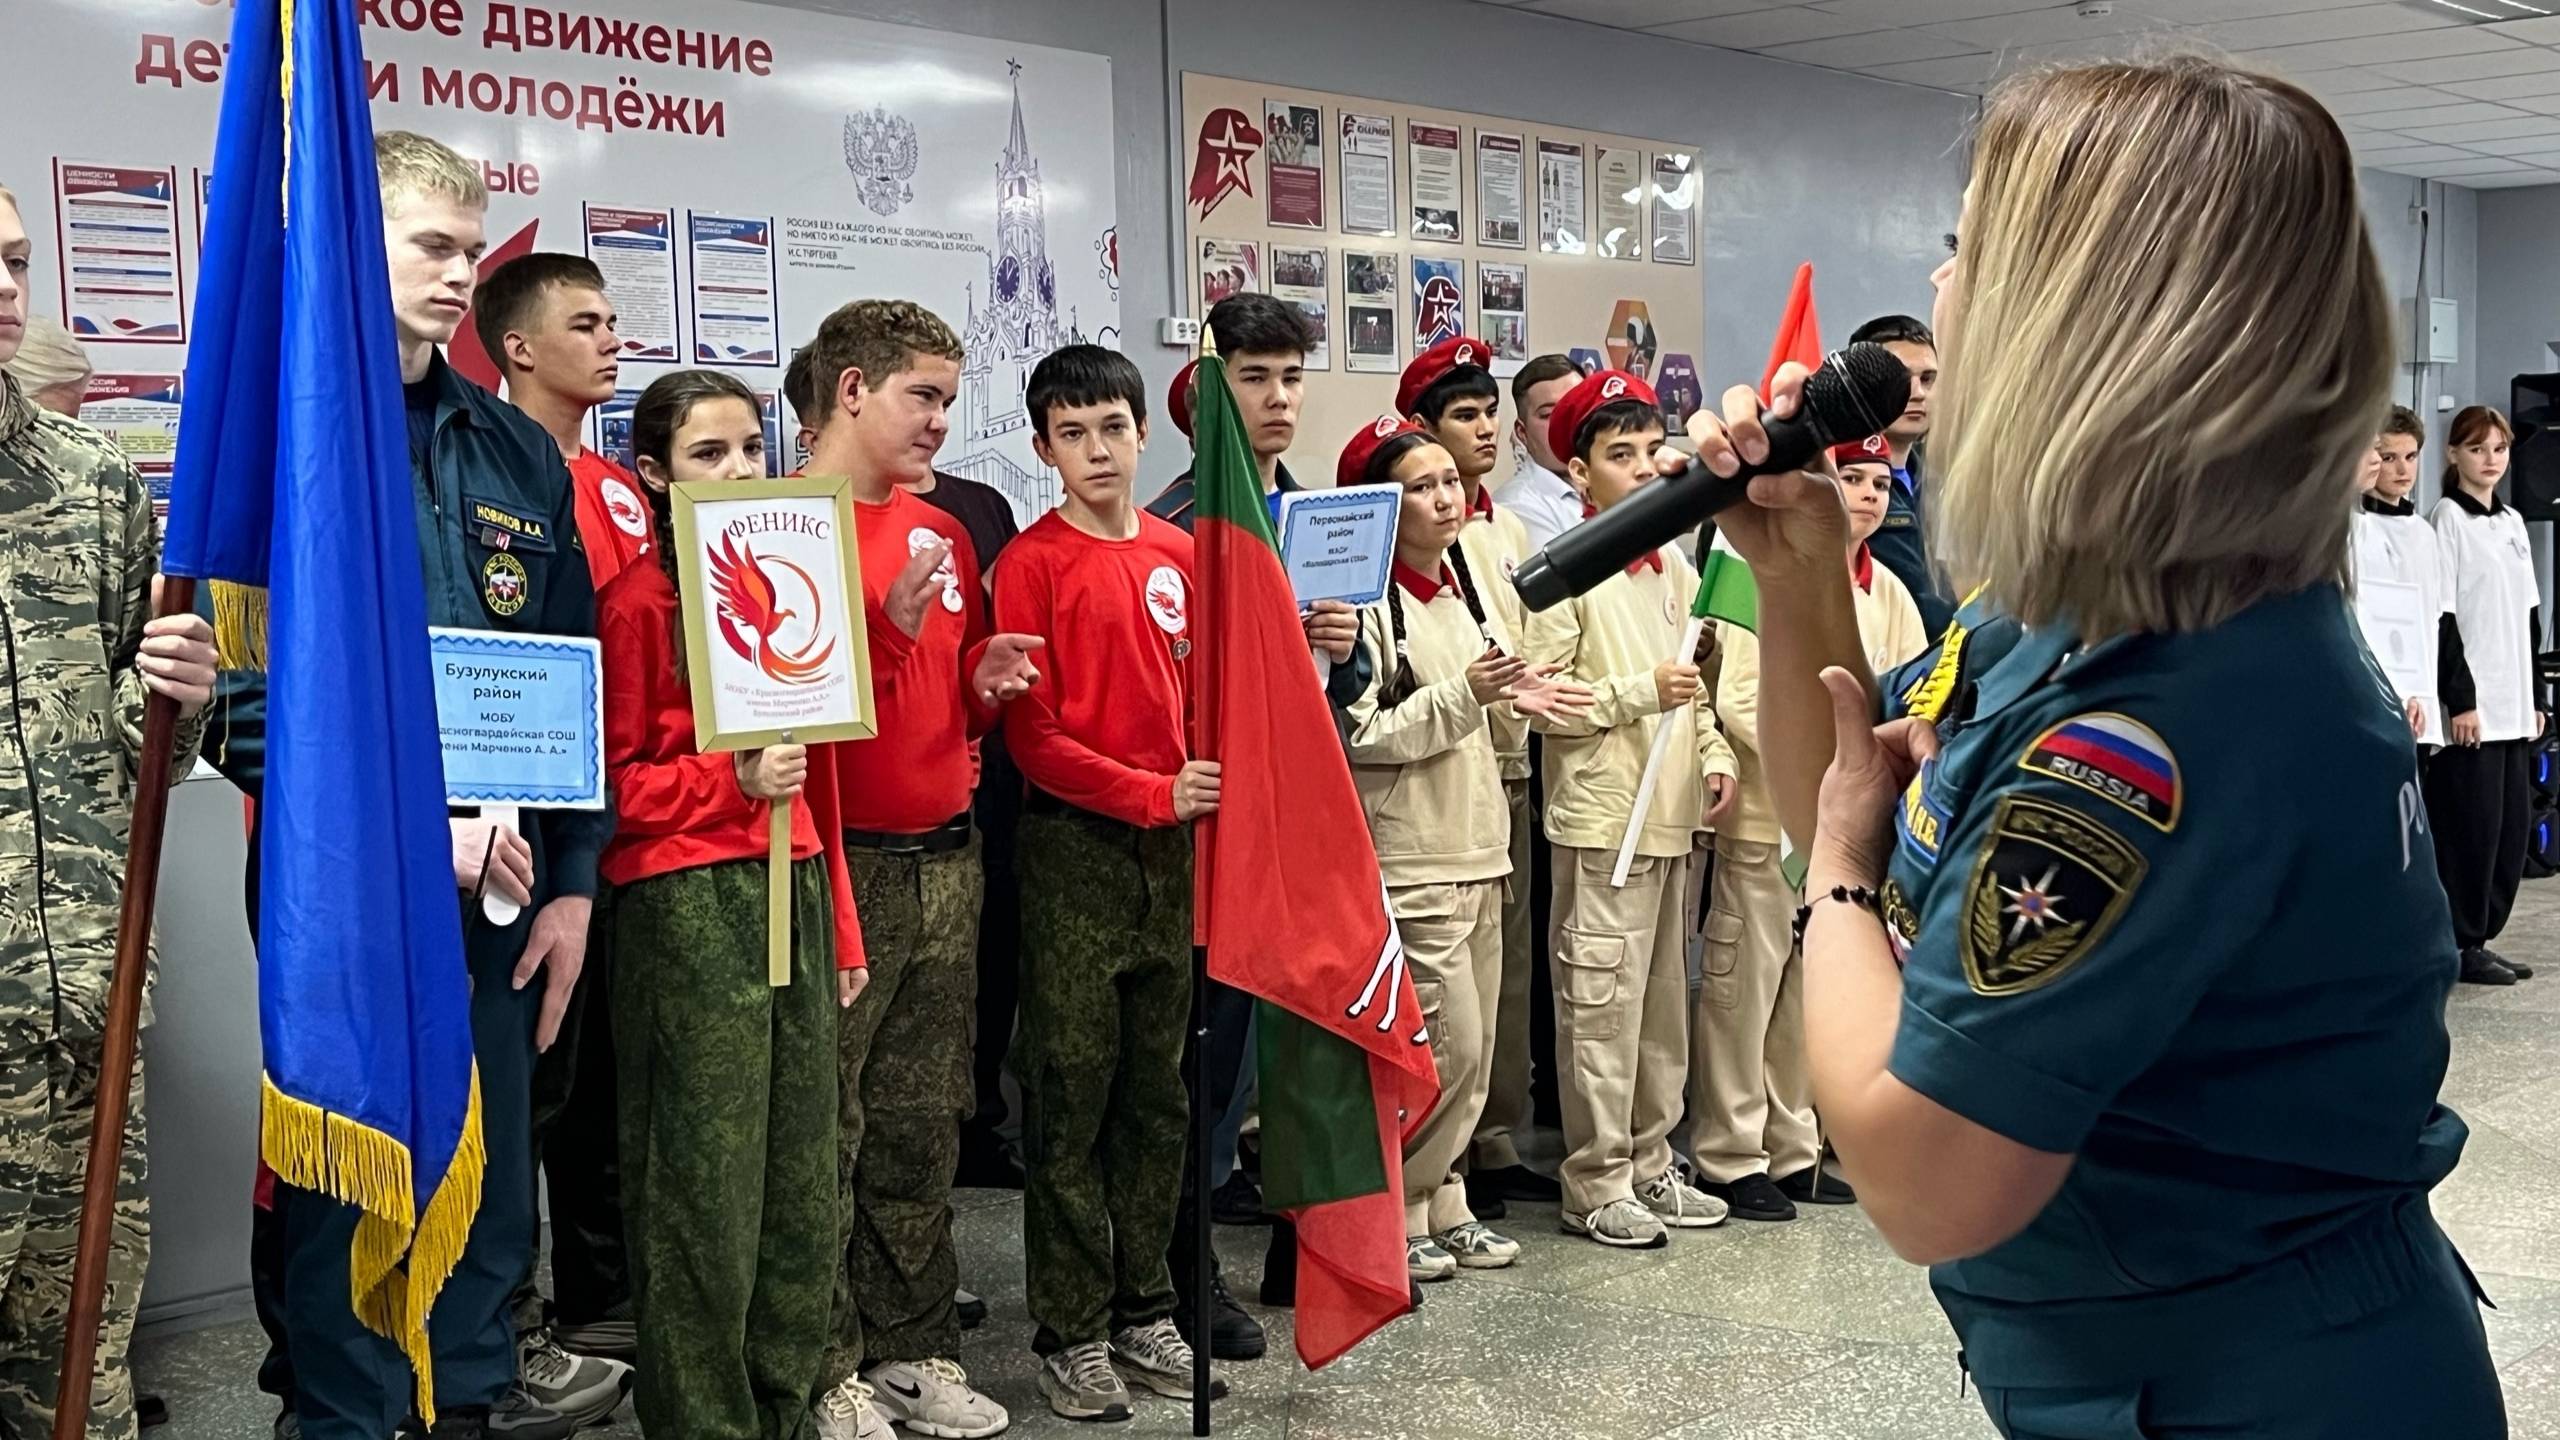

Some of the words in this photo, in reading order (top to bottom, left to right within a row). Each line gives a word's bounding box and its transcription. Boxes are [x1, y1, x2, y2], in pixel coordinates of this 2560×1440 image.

[358, 0, 464, 36] кое
[482, 3, 773, 76] движение
[423, 66, 725, 138] молодёжи
[476, 505, 521, 532] НОВИКОВ
[728, 511, 831, 540] ФЕНИКС
[1309, 509, 1375, 527] Первомайский
[1327, 527, 1354, 540] район
[445, 663, 548, 682] Бузулукский
[473, 684, 522, 701] район
[480, 712, 516, 723] МОБУ
[440, 727, 545, 741] асногвардейская
[547, 731, 576, 741] СОШ
[442, 742, 468, 752] ени
[471, 742, 532, 756] Марченко
[2049, 755, 2150, 813] RUSSIA
